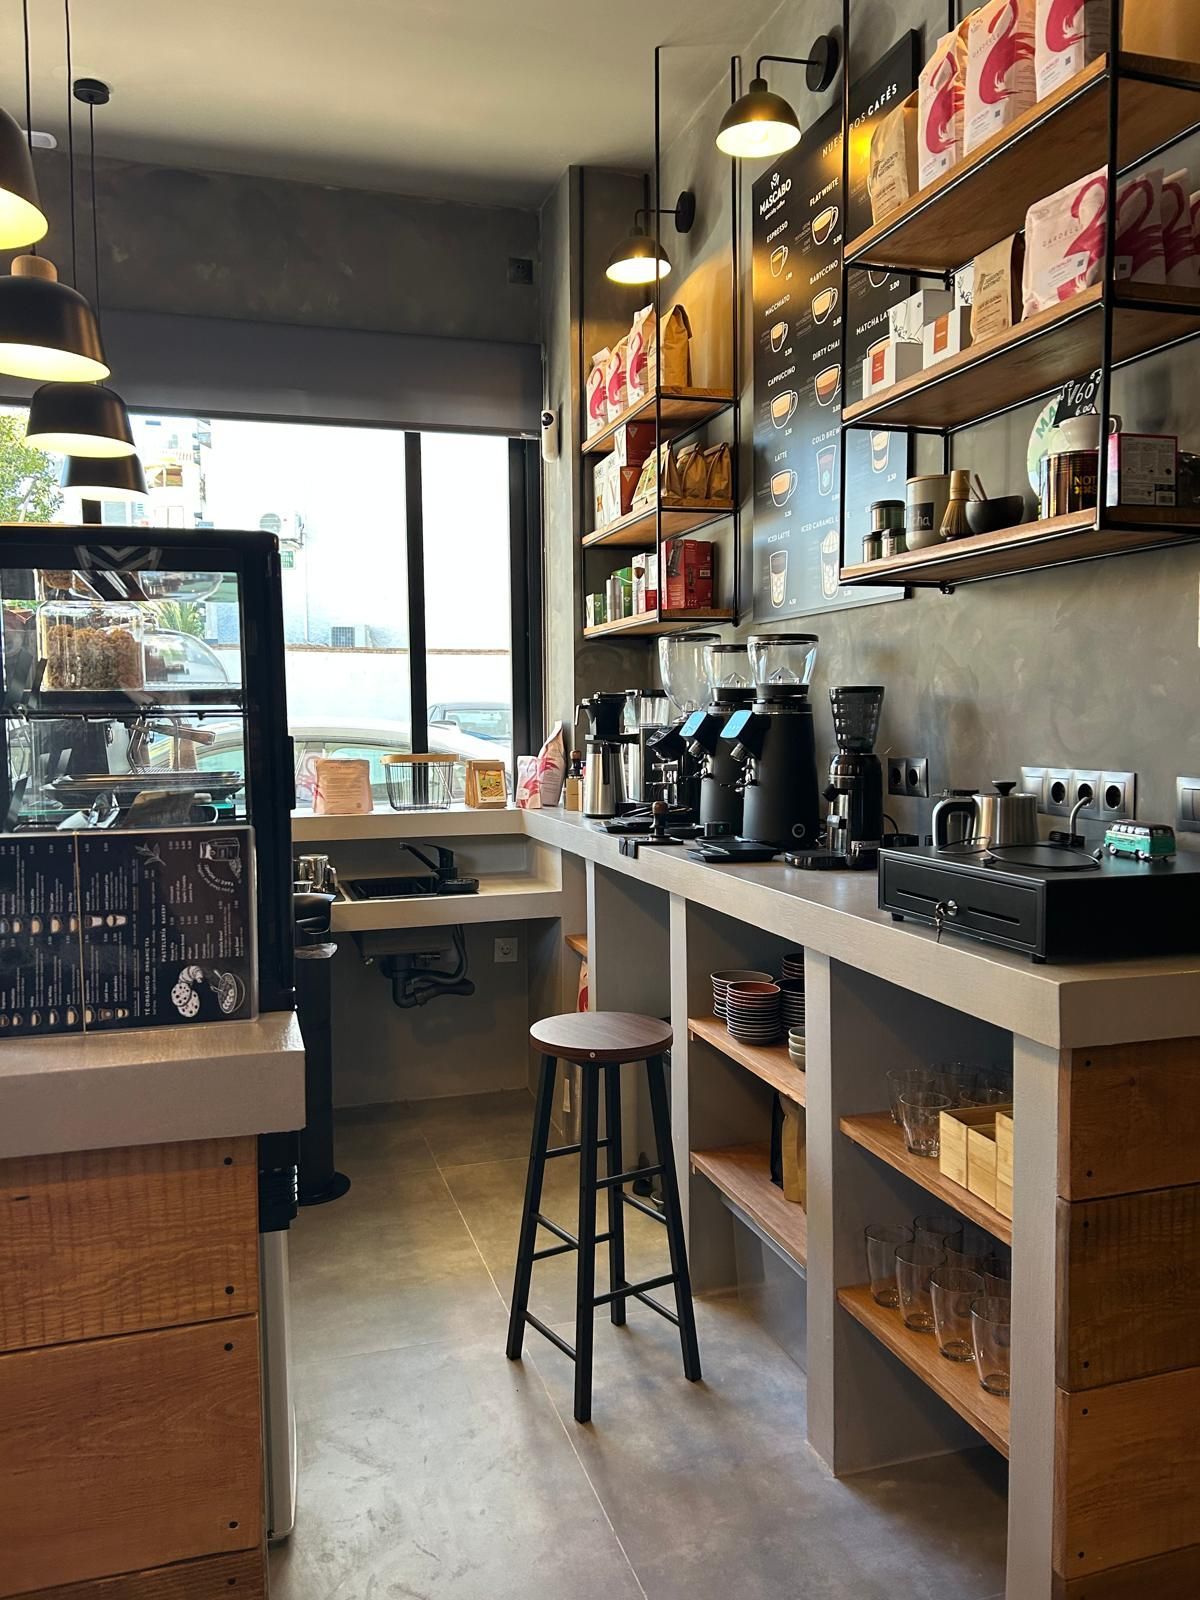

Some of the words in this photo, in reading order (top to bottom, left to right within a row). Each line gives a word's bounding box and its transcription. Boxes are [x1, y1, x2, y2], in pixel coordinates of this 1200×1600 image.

[822, 112, 866, 158] NUESROS
[867, 83, 898, 116] CAFÉS
[759, 178, 792, 216] MASCABO
[810, 190, 822, 207] FLAT
[822, 177, 839, 197] WHITE
[766, 220, 789, 243] ESPRESSO
[809, 260, 838, 285] BABYCCINO
[890, 280, 900, 291] 3.00
[765, 294, 791, 316] MACCHIATO
[856, 316, 880, 336] MATCHA
[812, 346, 827, 361] DIRTY
[827, 338, 840, 352] CHAI
[767, 365, 796, 387] CAPPUCCINO
[1067, 383, 1094, 406] V60
[1075, 404, 1093, 416] 6.00
[812, 434, 825, 445] COLD
[774, 450, 788, 462] LATTE
[801, 524, 812, 532] ICED
[813, 517, 834, 529] CARAMEL
[768, 535, 777, 543] ICED
[778, 530, 790, 540] LATTE
